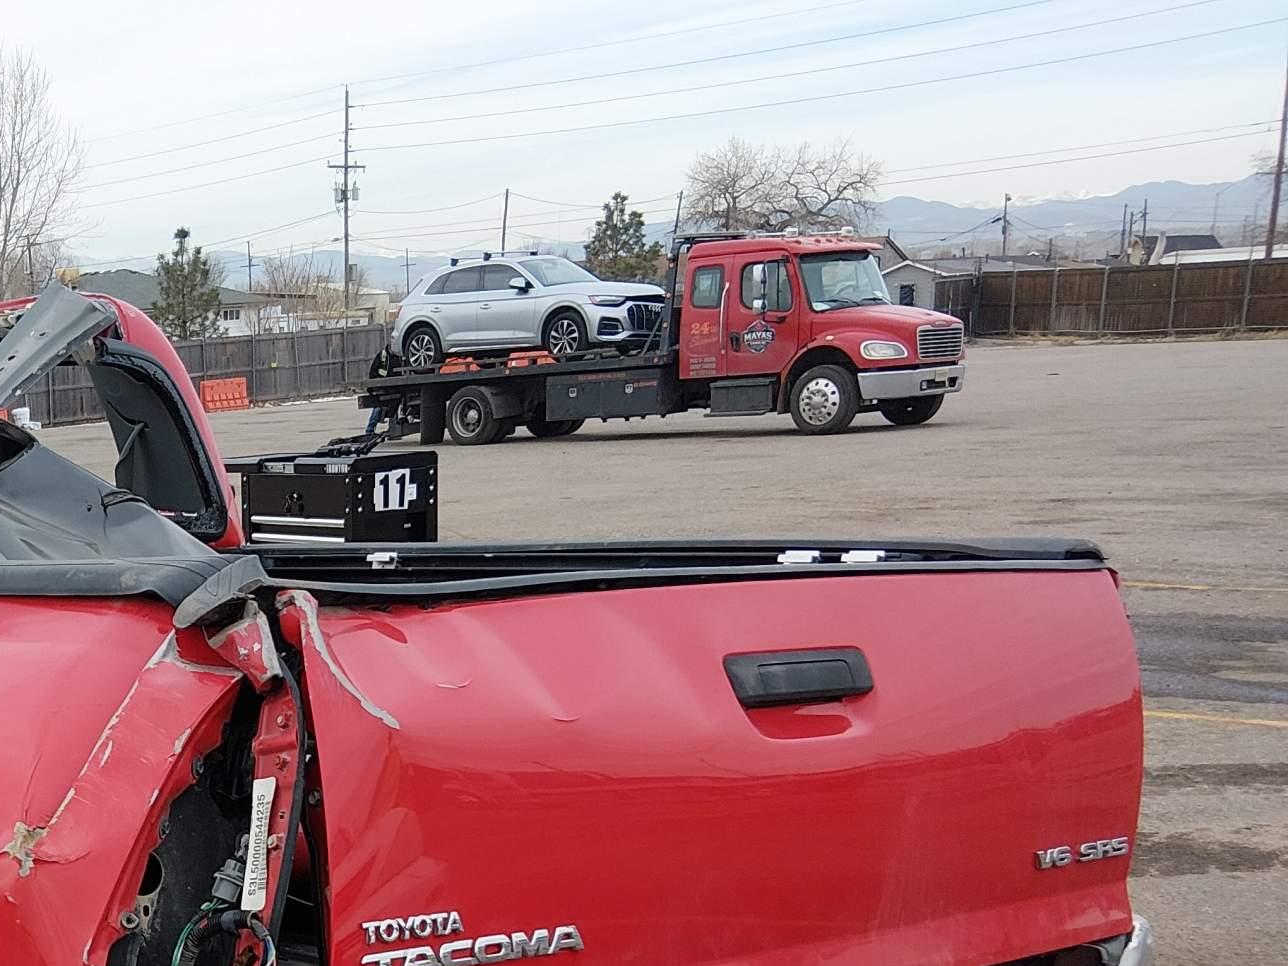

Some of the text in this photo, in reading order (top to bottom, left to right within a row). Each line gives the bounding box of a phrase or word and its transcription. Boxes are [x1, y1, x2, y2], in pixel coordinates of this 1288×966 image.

[743, 331, 773, 340] MAYAS
[379, 473, 407, 508] 11
[1036, 846, 1072, 869] V6
[361, 911, 465, 944] TOYOTA
